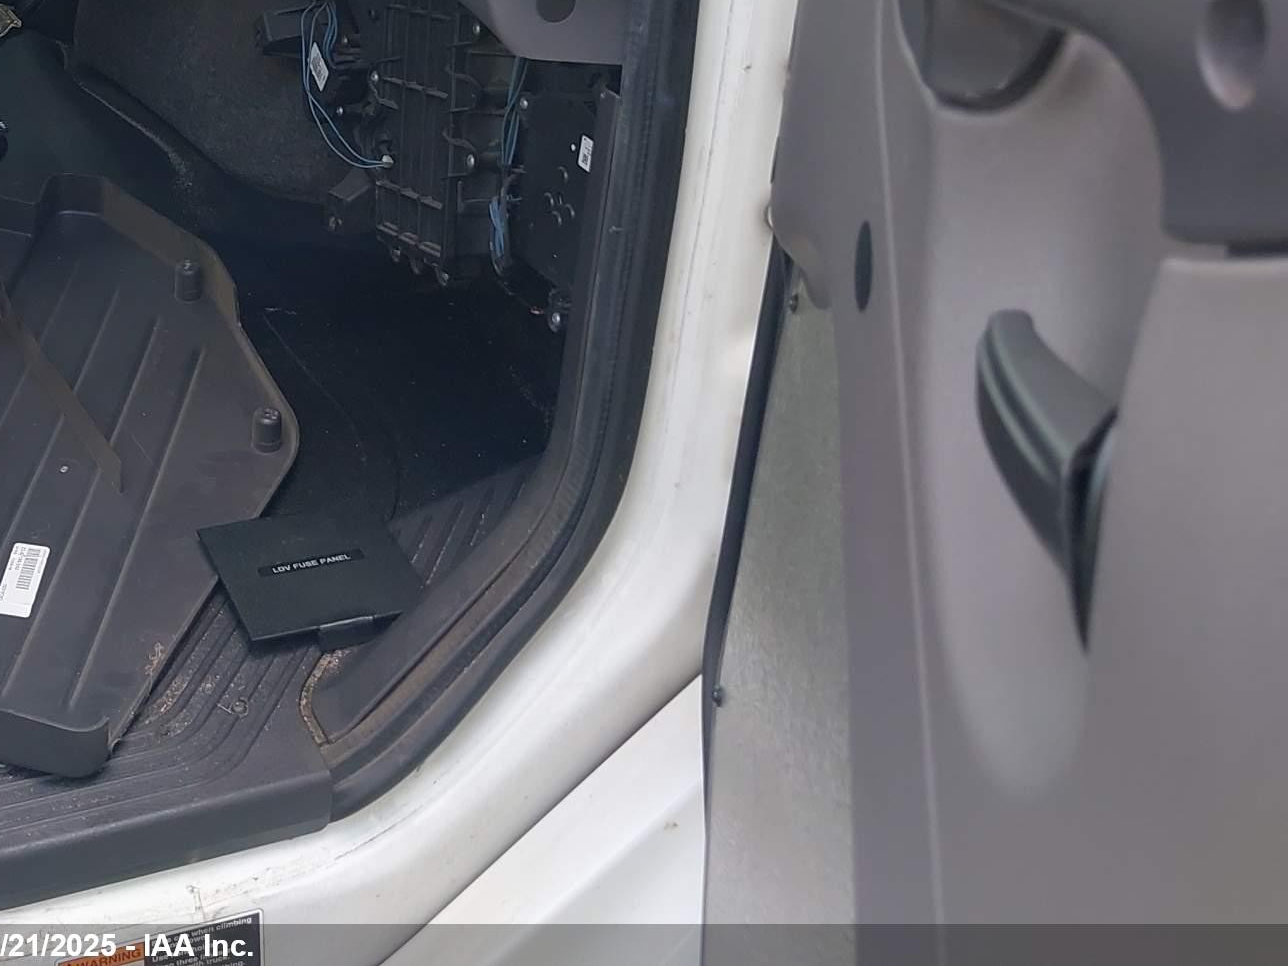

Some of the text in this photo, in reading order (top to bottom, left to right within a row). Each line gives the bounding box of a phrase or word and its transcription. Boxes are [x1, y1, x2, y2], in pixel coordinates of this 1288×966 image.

[272, 553, 351, 573] LDV FUSE PANEL
[216, 917, 252, 930] climbing
